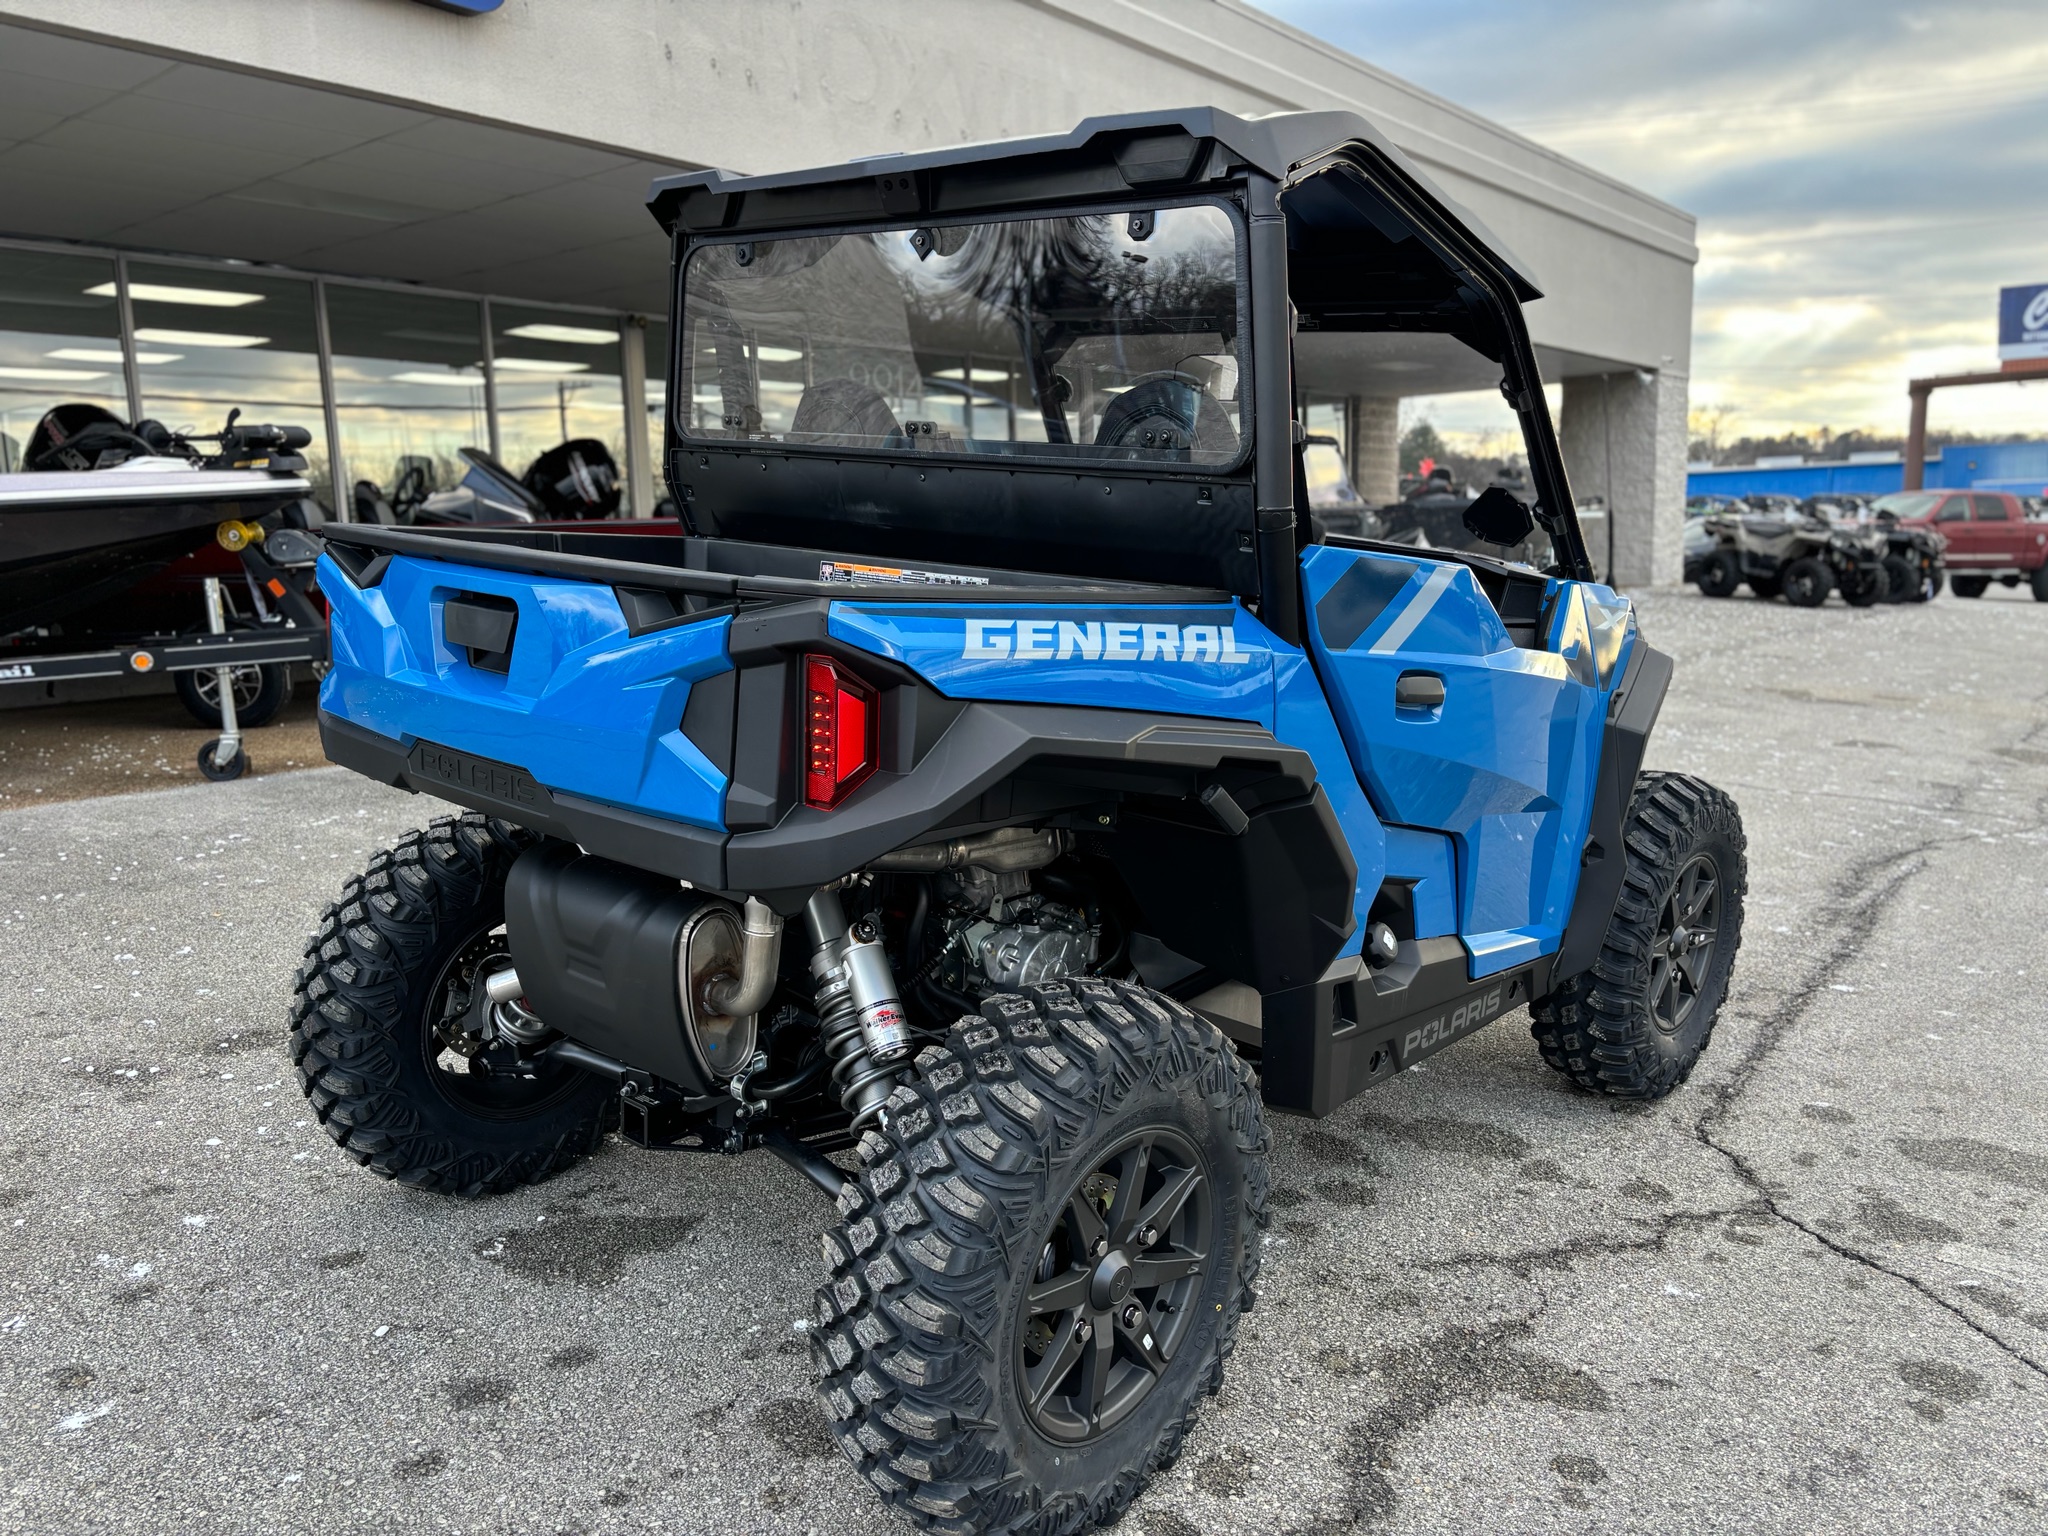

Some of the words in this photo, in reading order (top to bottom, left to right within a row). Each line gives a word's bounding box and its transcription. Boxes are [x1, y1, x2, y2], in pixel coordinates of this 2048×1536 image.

[961, 619, 1250, 664] GENERAL
[420, 748, 537, 806] POLARIS
[1402, 986, 1501, 1059] POLARIS
